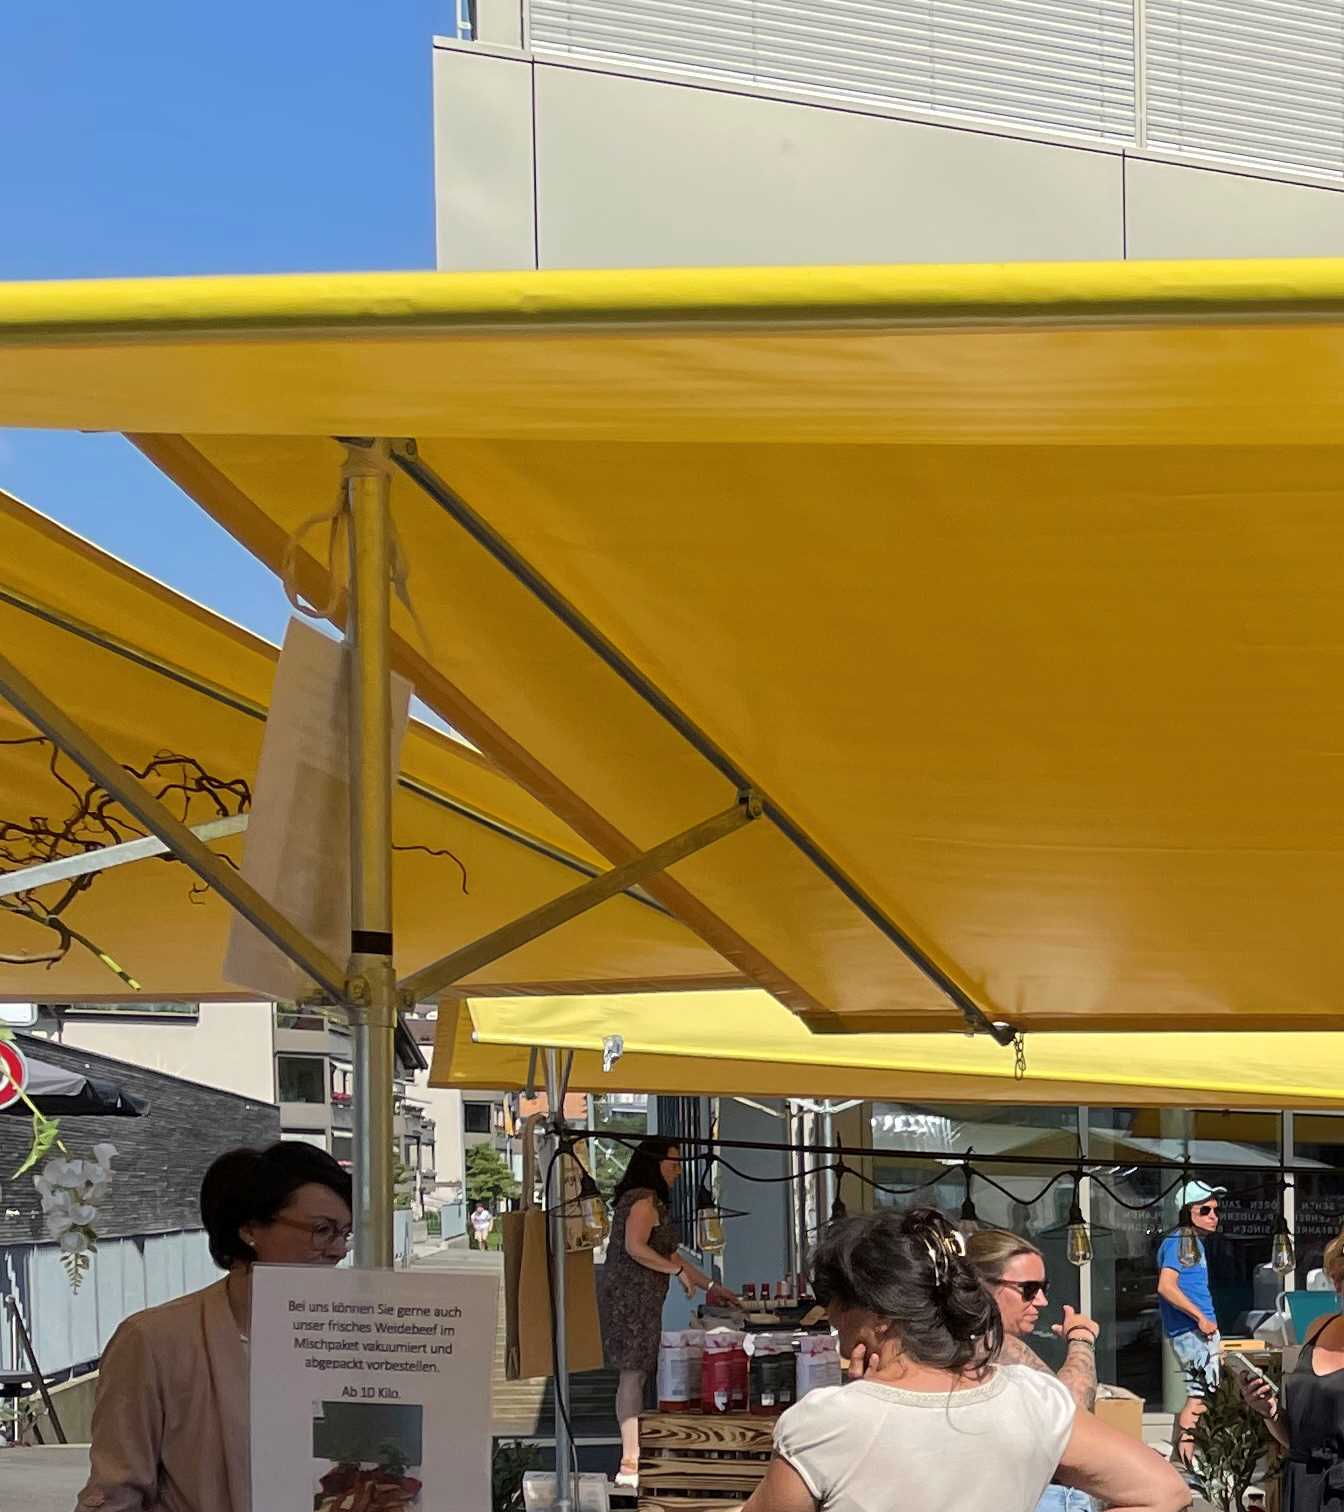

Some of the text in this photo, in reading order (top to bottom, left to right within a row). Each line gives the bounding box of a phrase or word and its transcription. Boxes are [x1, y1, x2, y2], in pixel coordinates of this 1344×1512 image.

[288, 1301, 462, 1318] Bei uns können Sie gerne auch
[293, 1320, 455, 1336] unser frisches Weidebeef im
[294, 1338, 452, 1354] Mischpaket vakuumiert und
[305, 1357, 440, 1372] abgepackt vorbestellen.
[342, 1386, 402, 1399] Ab 10 Kilo.
